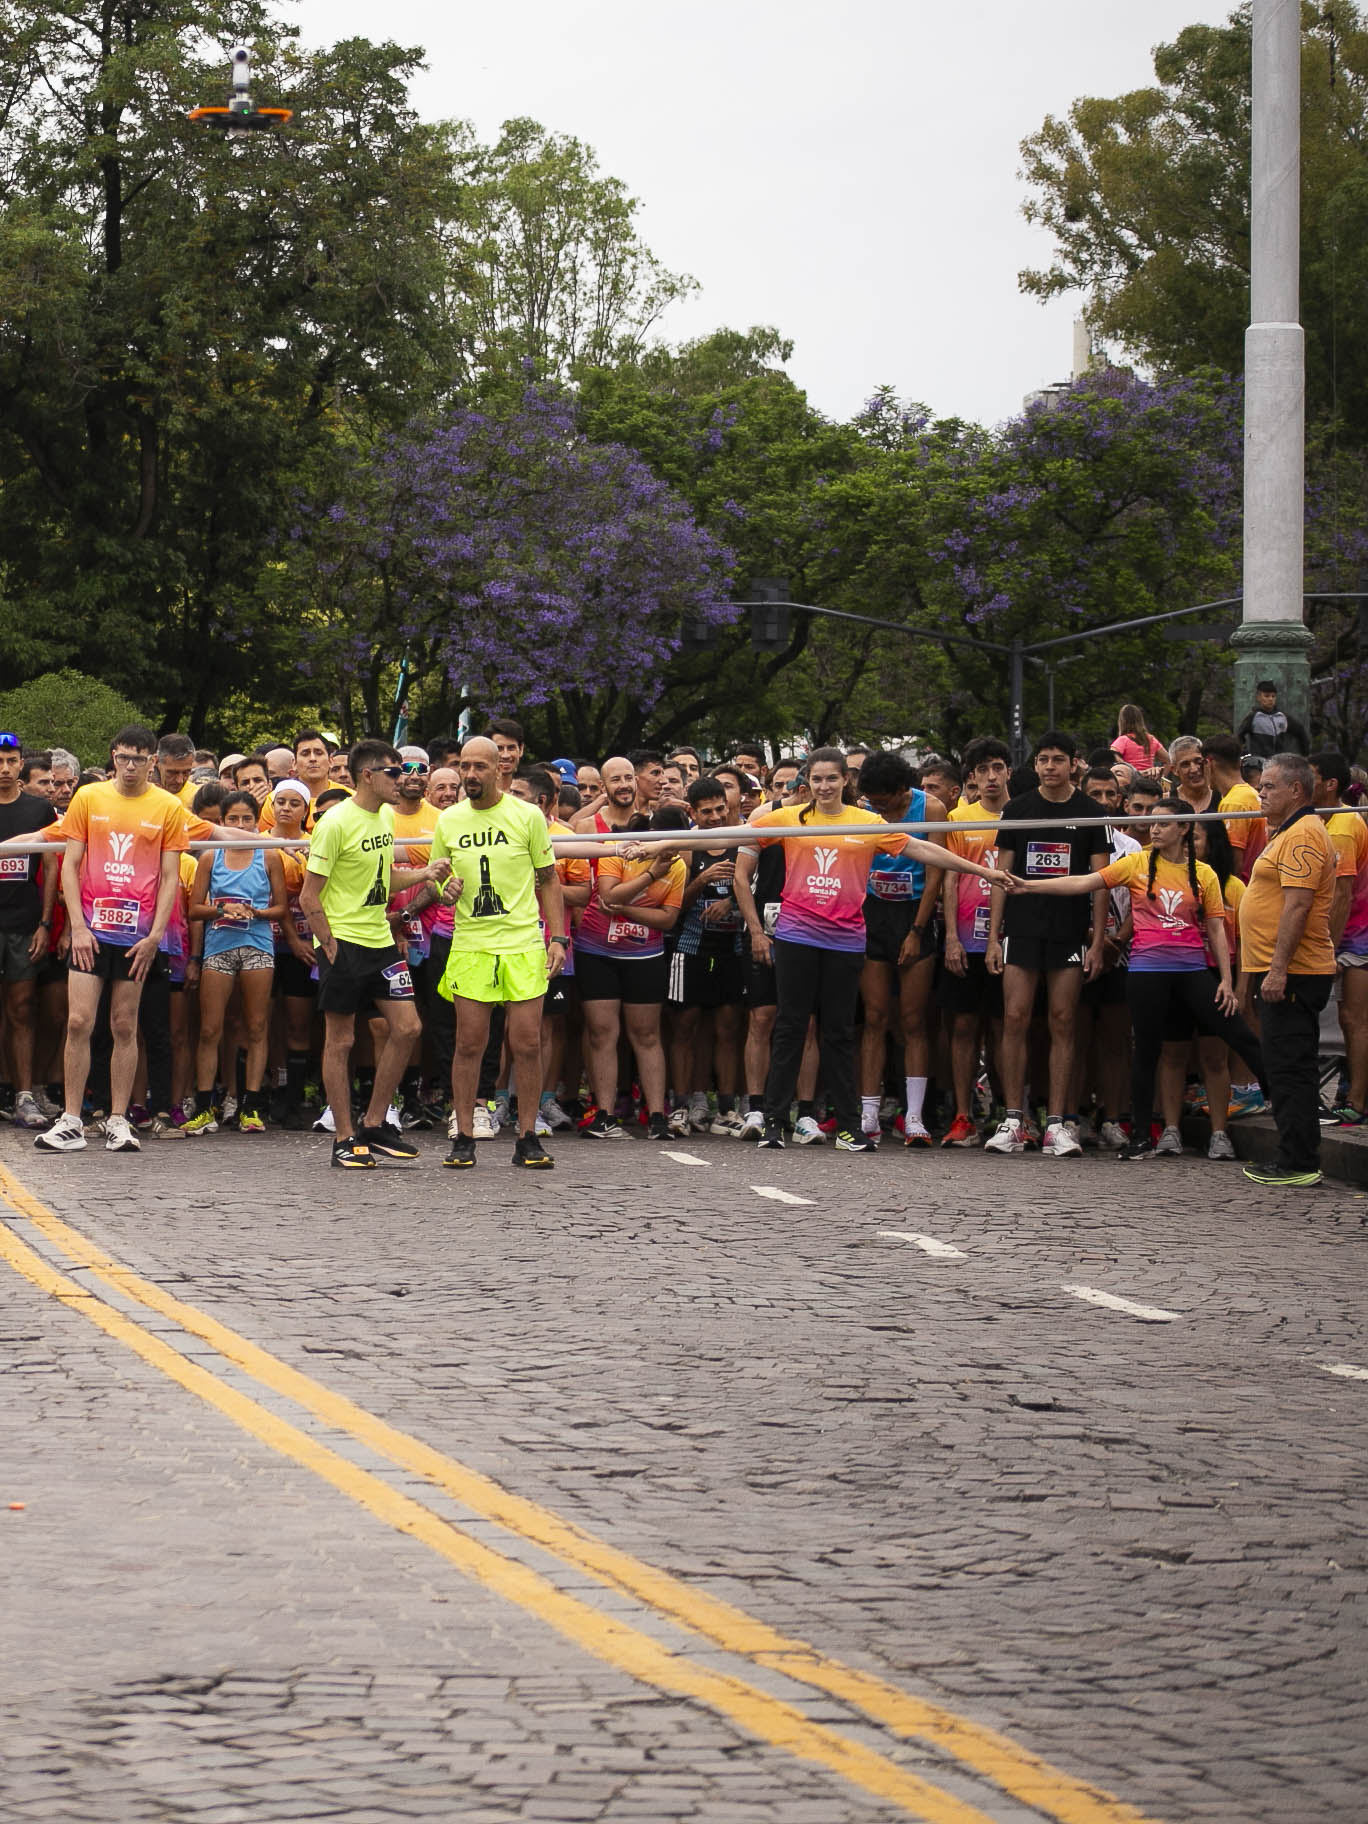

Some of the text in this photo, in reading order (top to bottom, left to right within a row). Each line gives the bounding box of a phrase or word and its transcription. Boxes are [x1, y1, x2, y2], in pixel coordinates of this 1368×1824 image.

[458, 827, 509, 848] GUÍA
[1035, 854, 1061, 866] 263
[103, 862, 135, 876] COPA
[806, 875, 841, 889] COPA
[99, 909, 133, 924] 5882
[615, 924, 645, 936] 5643
